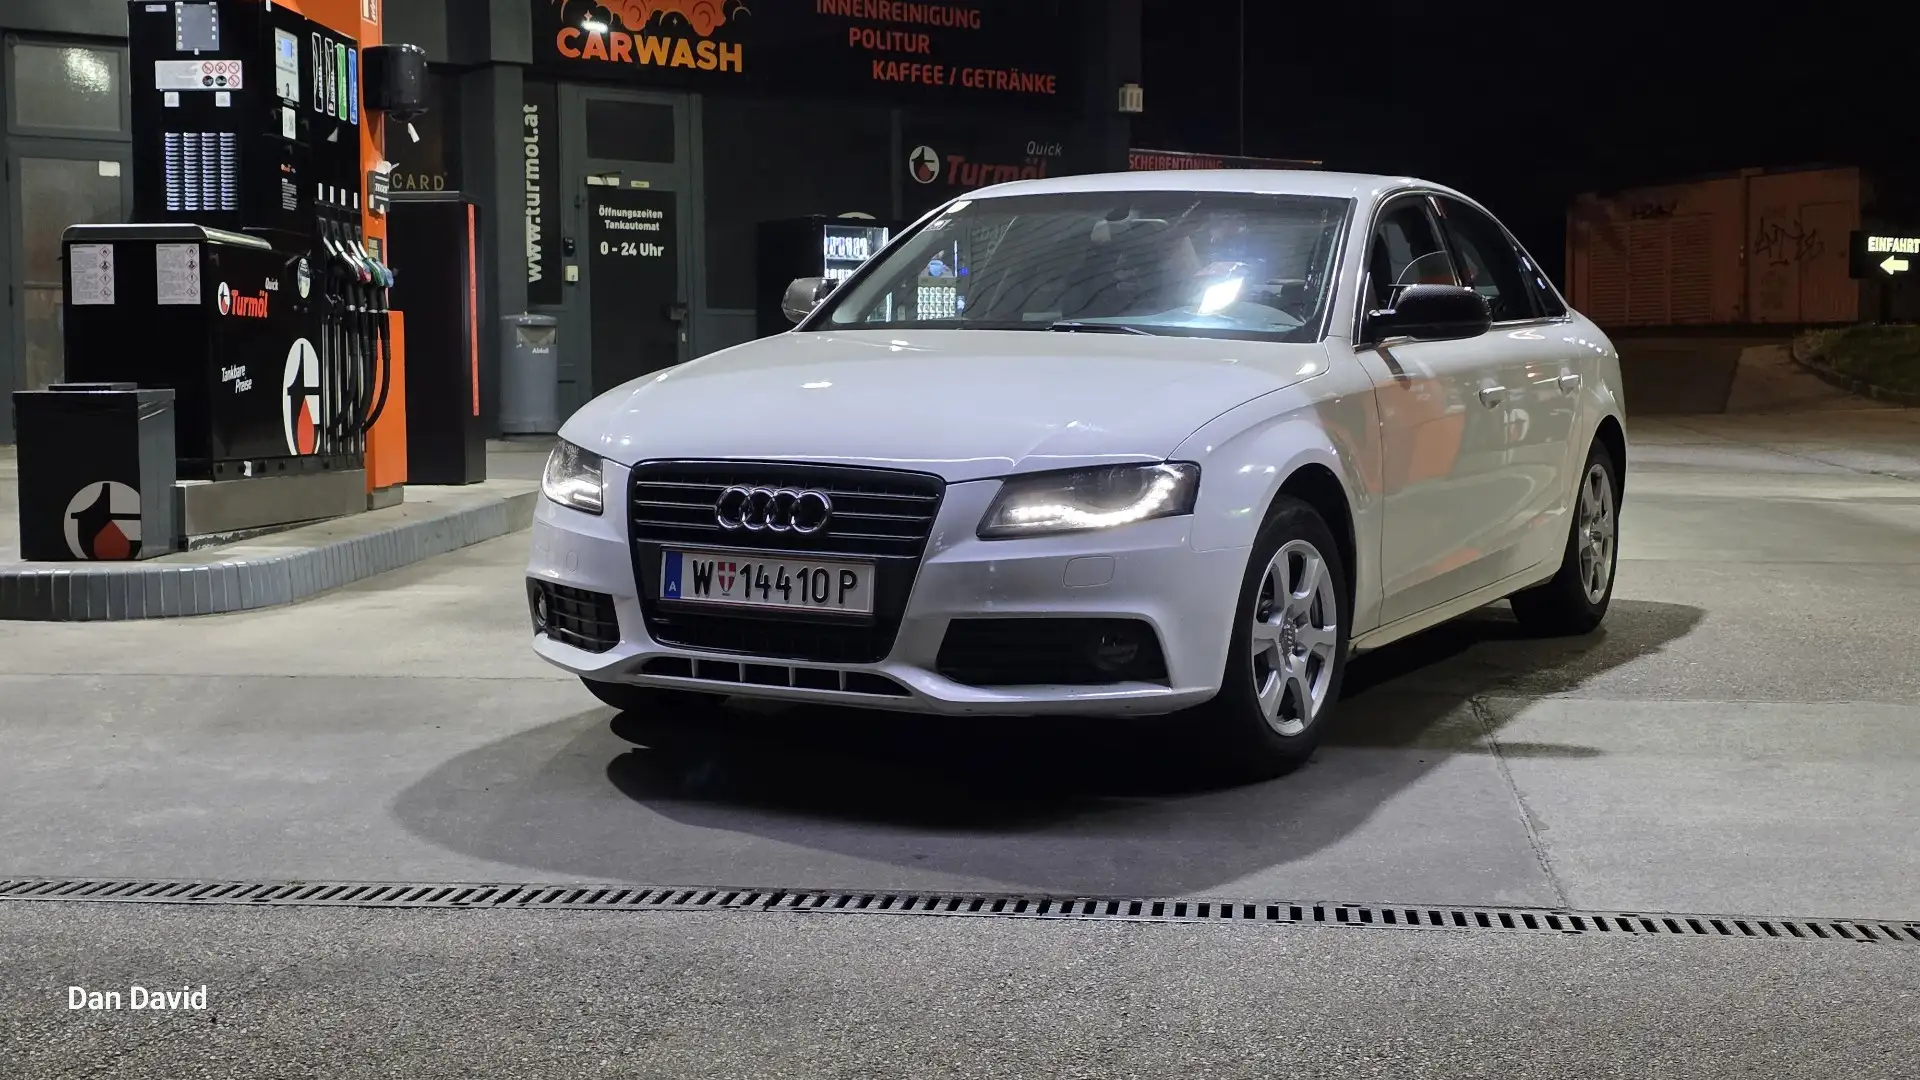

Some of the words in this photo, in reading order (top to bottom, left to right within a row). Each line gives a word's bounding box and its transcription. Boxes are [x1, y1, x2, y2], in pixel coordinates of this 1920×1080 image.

[816, 0, 981, 29] INNENREINIGUNG
[849, 27, 930, 54] POLITUR
[556, 27, 742, 73] CARWASH
[872, 59, 944, 85] KAFFEE
[949, 67, 957, 86] /
[961, 67, 1057, 94] GETRÄNKE
[1026, 140, 1063, 157] Quick
[392, 172, 445, 191] CARD
[598, 205, 663, 219] Öffnungszeiten
[604, 219, 660, 231] Tankautomat
[600, 241, 609, 255] 0
[621, 241, 637, 256] 24
[640, 242, 664, 257] Uhr
[1867, 236, 1920, 254] EINFAHRT
[265, 276, 279, 292] Quick
[231, 289, 269, 319] Turmöl
[221, 364, 246, 383] Tankbare
[235, 377, 253, 394] Preise
[668, 581, 677, 592] A
[692, 559, 714, 596] W
[739, 562, 830, 604] 14410
[838, 568, 858, 605] P
